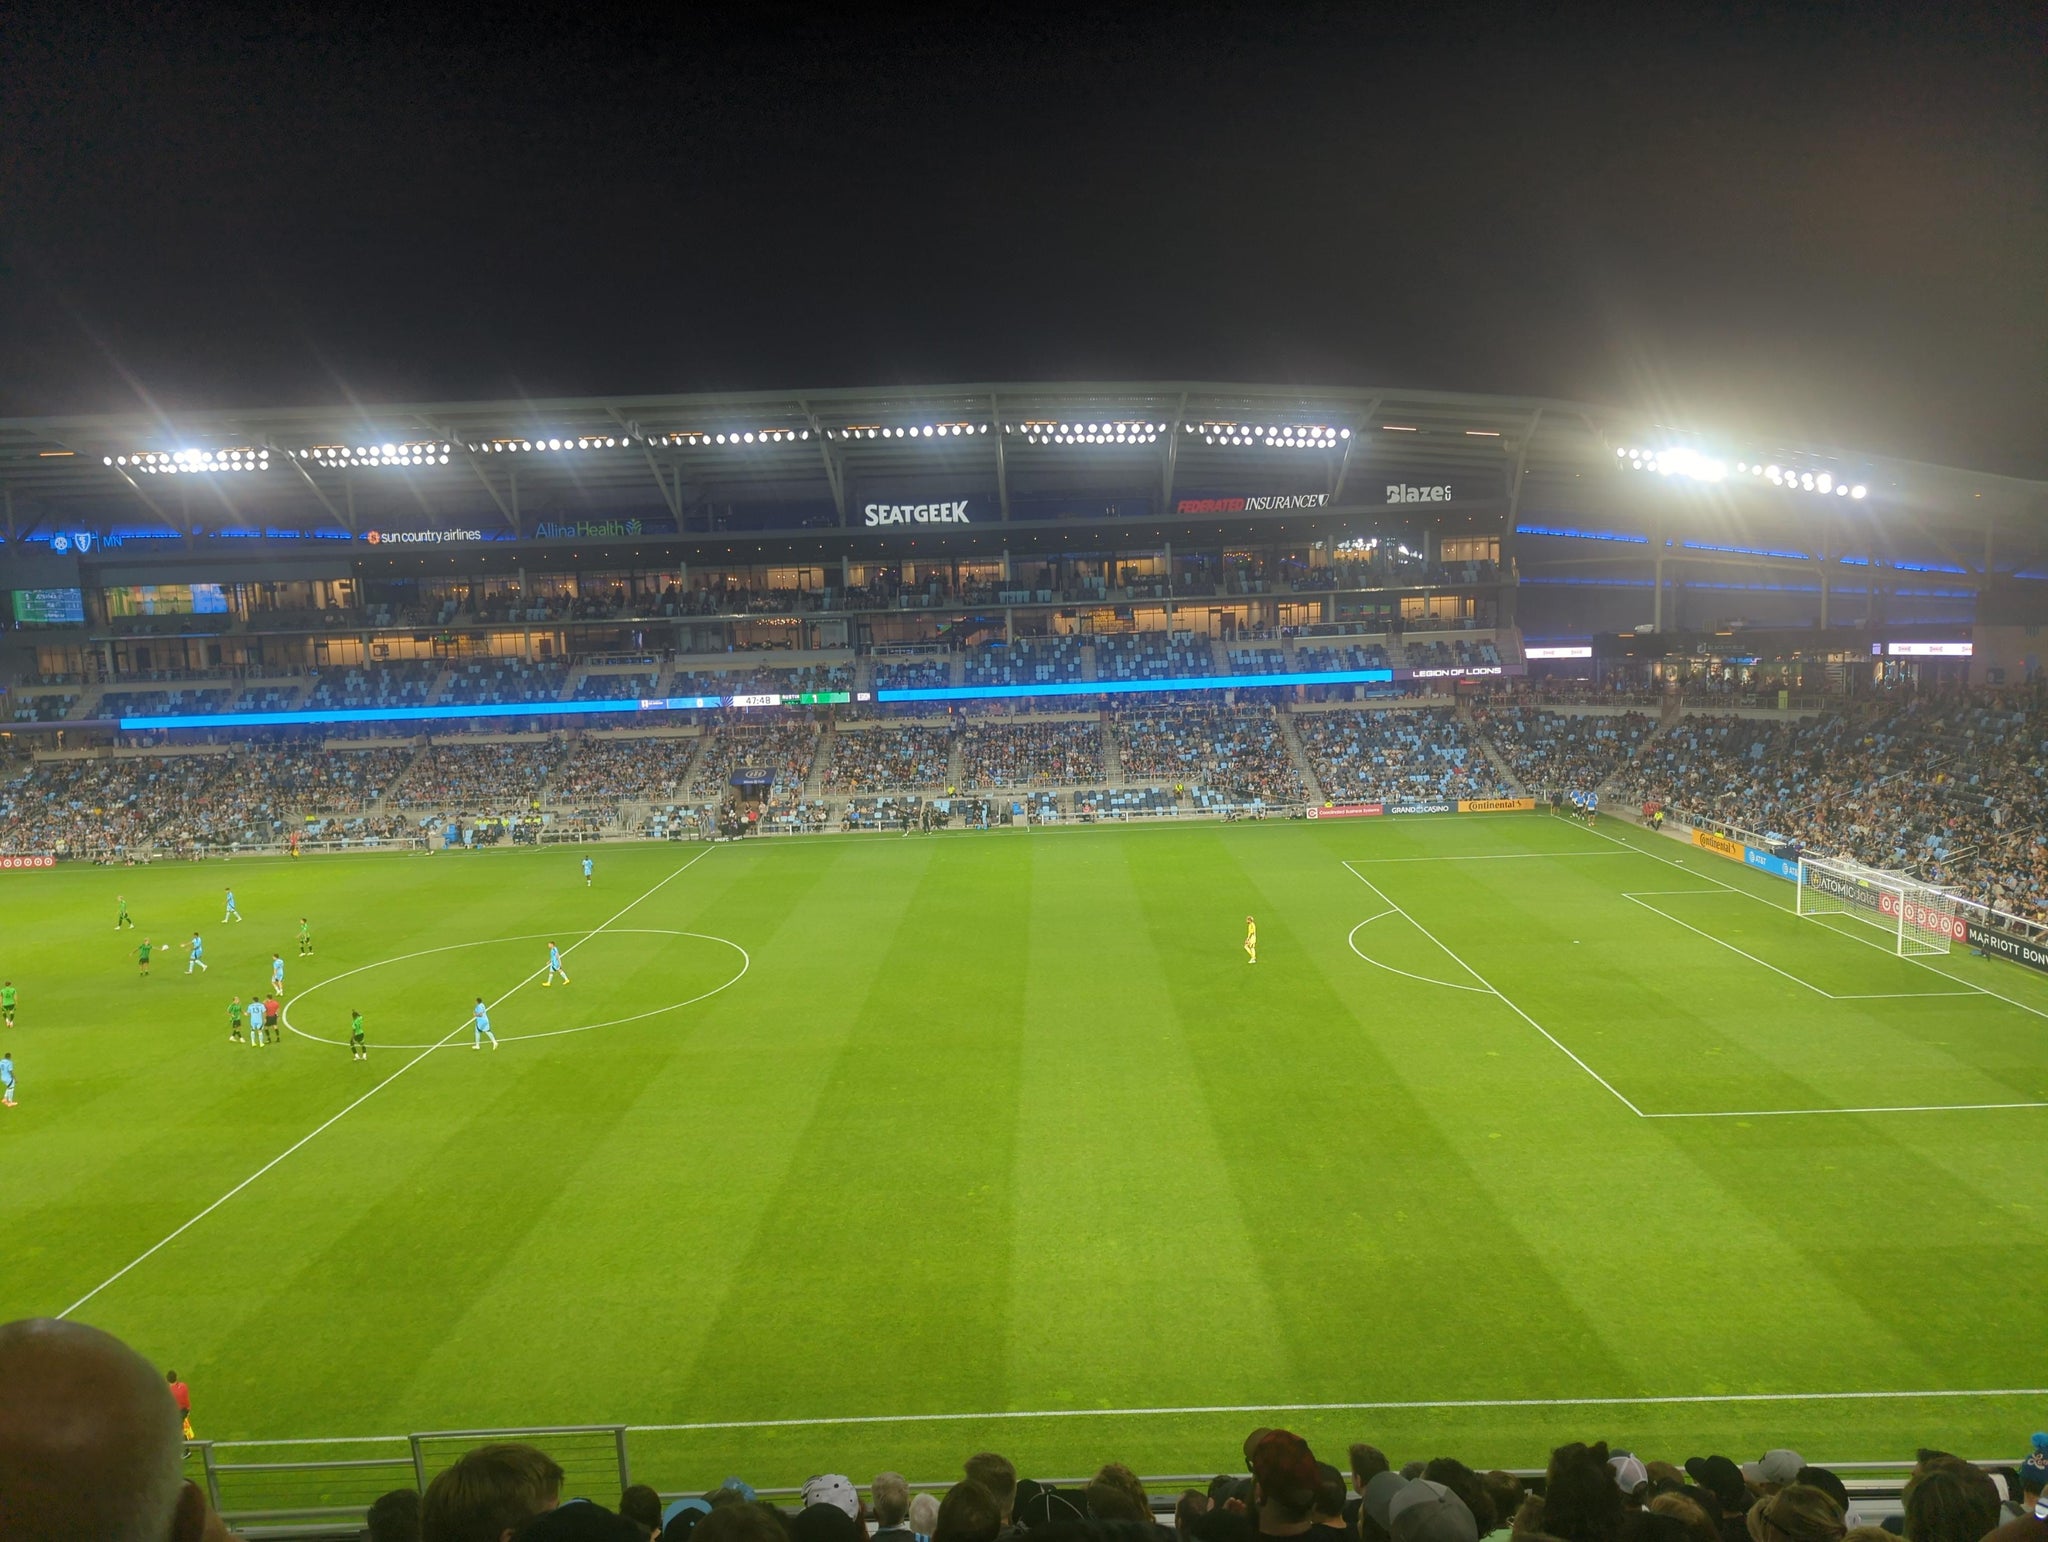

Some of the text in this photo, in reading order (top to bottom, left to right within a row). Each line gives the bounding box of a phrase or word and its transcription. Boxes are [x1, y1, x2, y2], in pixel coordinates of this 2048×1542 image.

[1386, 483, 1444, 504] Blaze
[1177, 494, 1318, 513] FEDERATED INSURANCE
[864, 500, 970, 527] SEATGEEK
[401, 530, 441, 544] country
[443, 528, 481, 541] airlines
[535, 520, 624, 539] Allina Health
[103, 536, 122, 547] MN
[1412, 667, 1502, 678] LEGION OF LOONS
[1391, 805, 1449, 814] GRAND CASINO
[1468, 800, 1515, 811] Continental
[1699, 833, 1731, 853] Continental
[1969, 928, 2048, 966] MARRIOTT BON
